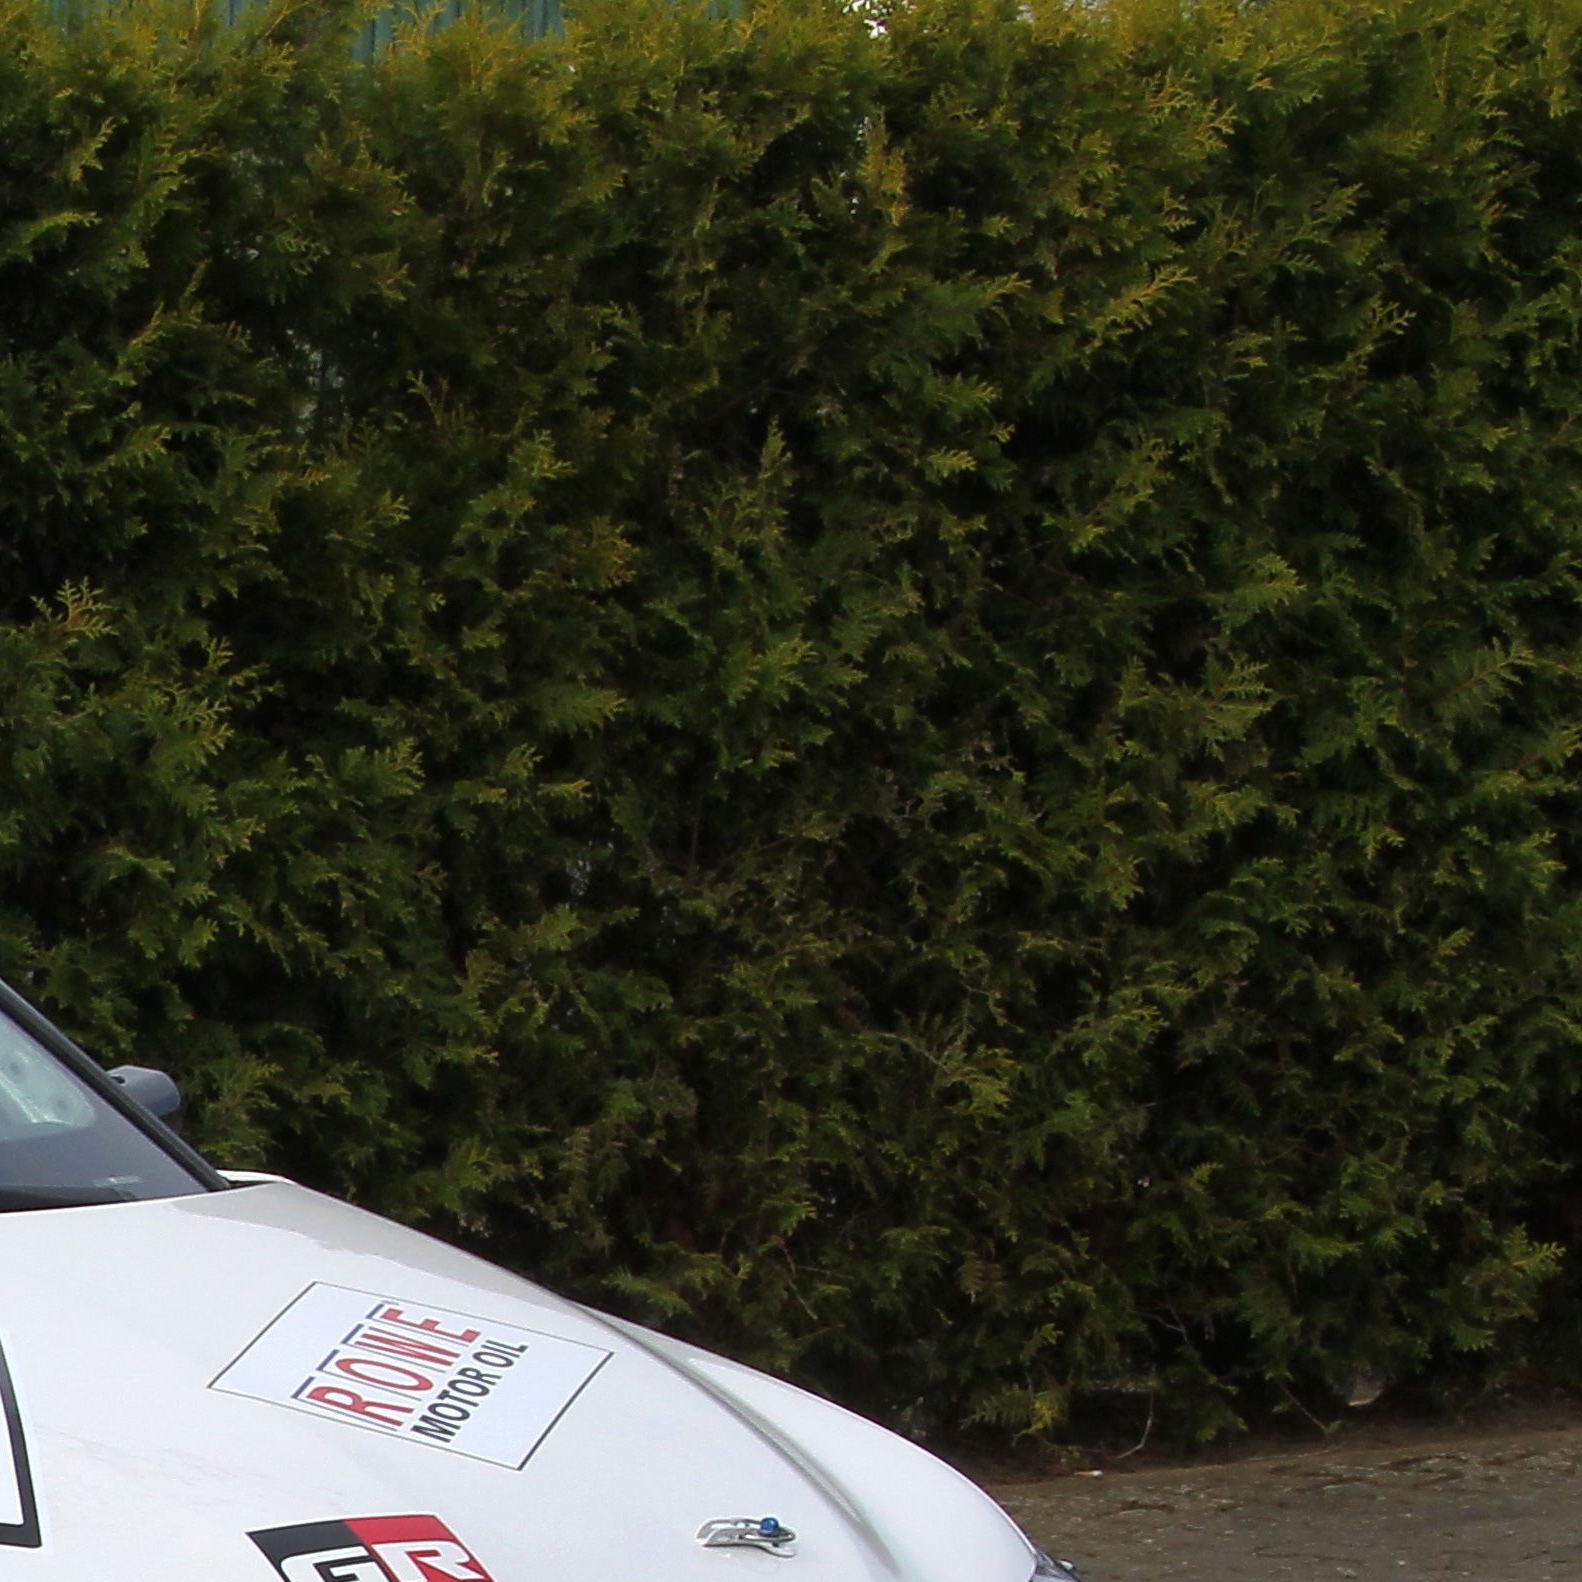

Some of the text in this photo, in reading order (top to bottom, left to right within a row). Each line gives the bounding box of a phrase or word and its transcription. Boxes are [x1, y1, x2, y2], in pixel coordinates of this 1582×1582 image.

[305, 1307, 482, 1428] ROWE
[409, 1338, 530, 1444] MOTOR OIL
